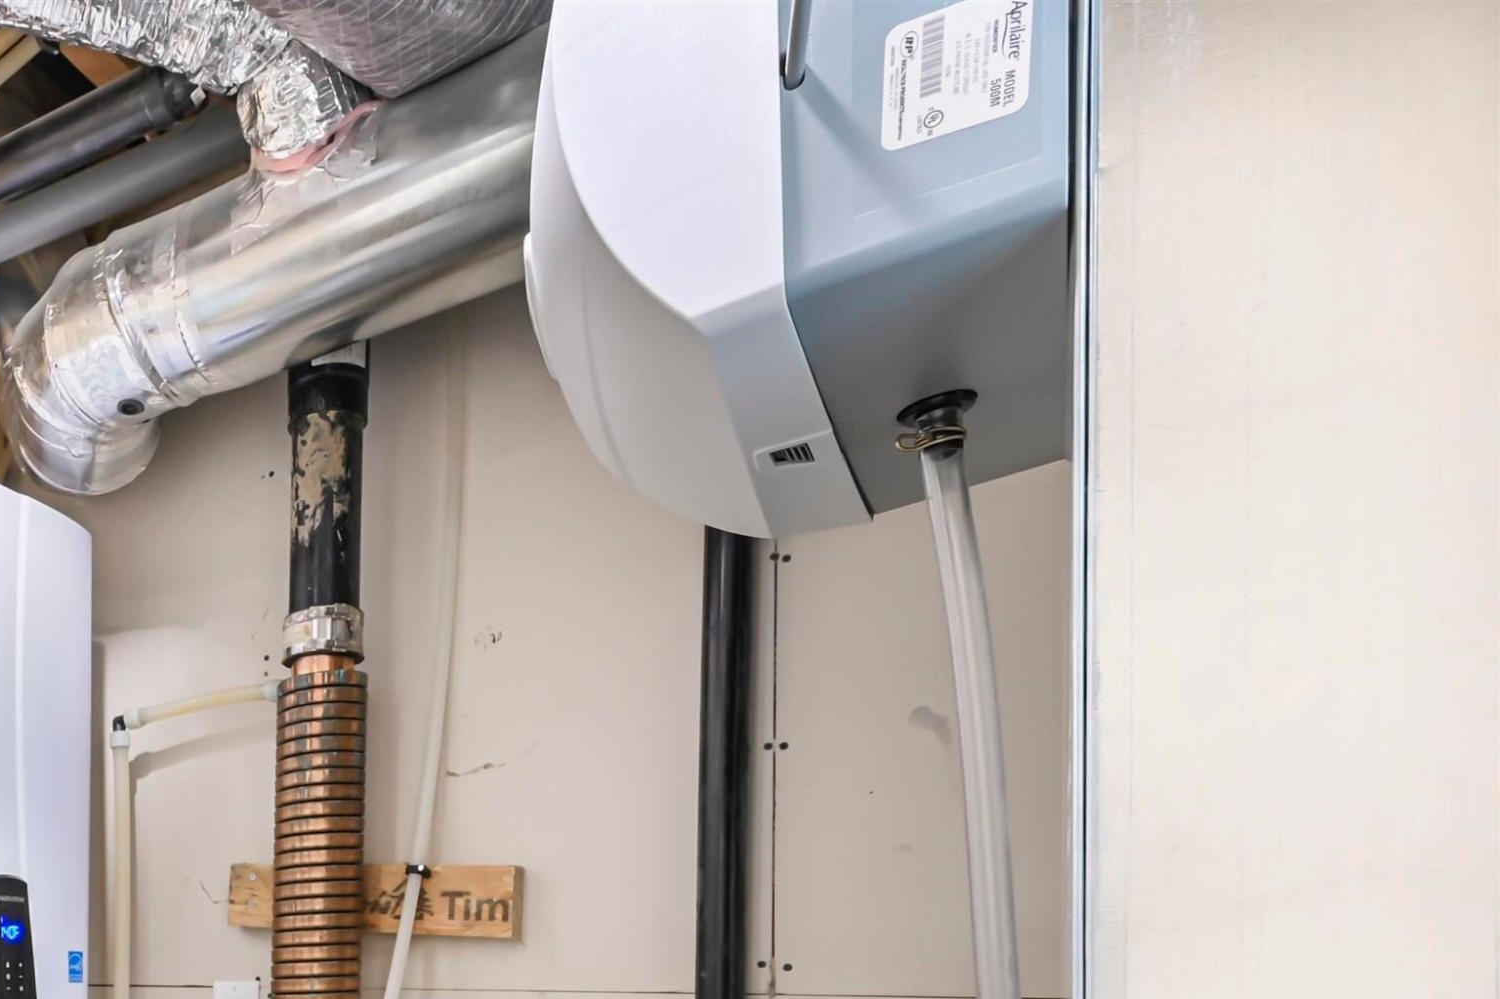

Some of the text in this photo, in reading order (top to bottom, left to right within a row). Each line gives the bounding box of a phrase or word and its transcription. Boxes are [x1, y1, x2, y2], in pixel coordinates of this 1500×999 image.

[1006, 0, 1028, 60] Aprilaire
[989, 78, 1002, 107] 500M
[1002, 69, 1016, 108] MODEL
[440, 890, 510, 922] Tim
